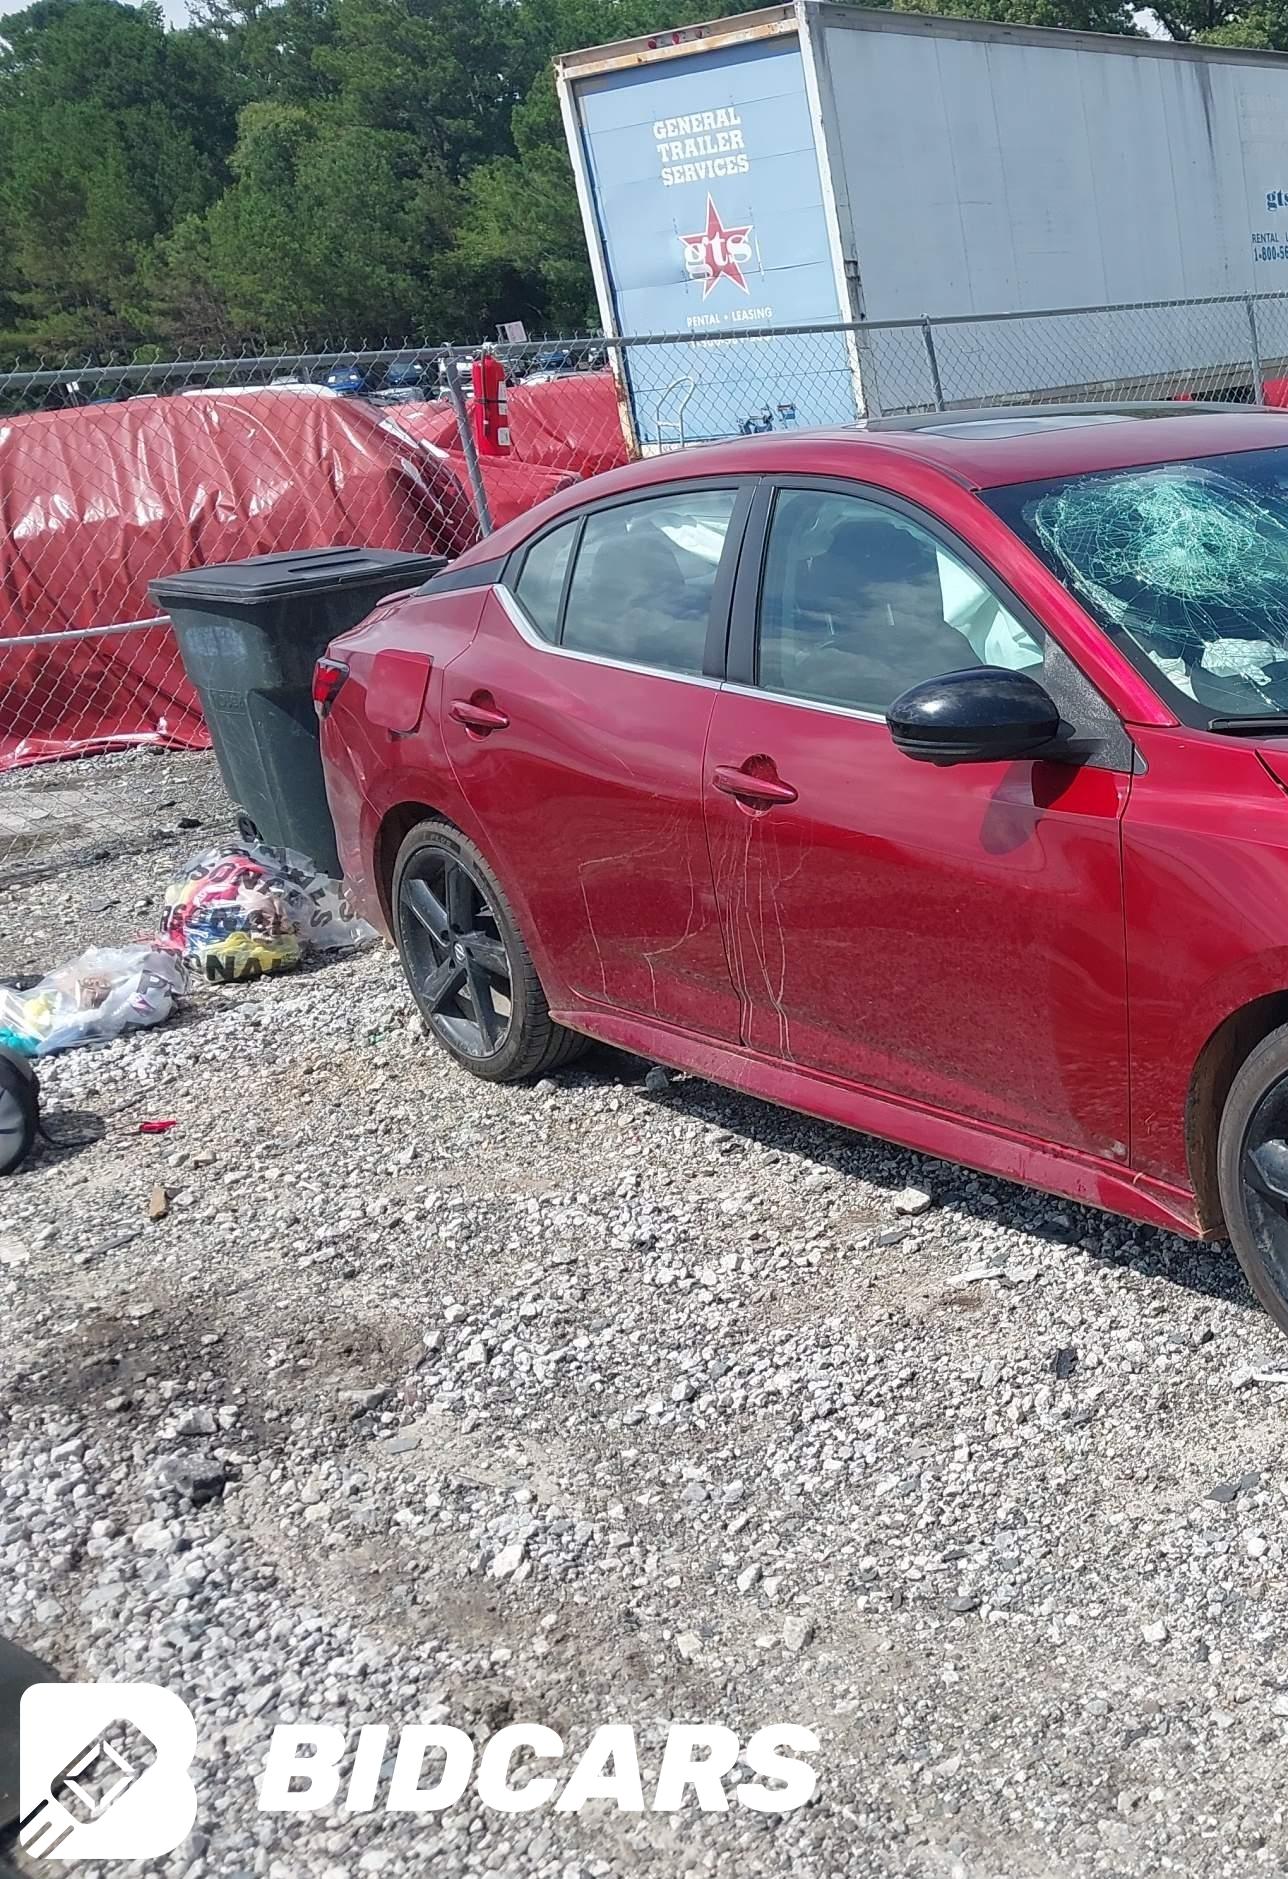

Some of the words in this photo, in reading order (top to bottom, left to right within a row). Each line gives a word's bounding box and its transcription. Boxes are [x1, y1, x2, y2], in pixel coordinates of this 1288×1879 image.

[653, 107, 741, 140] GENERAL
[656, 129, 745, 162] TRAILER
[661, 154, 749, 186] SERVICES
[1251, 233, 1279, 243] RENTAL
[684, 231, 752, 282] gts
[687, 313, 720, 328] RENTAL
[731, 307, 773, 321] LEASING
